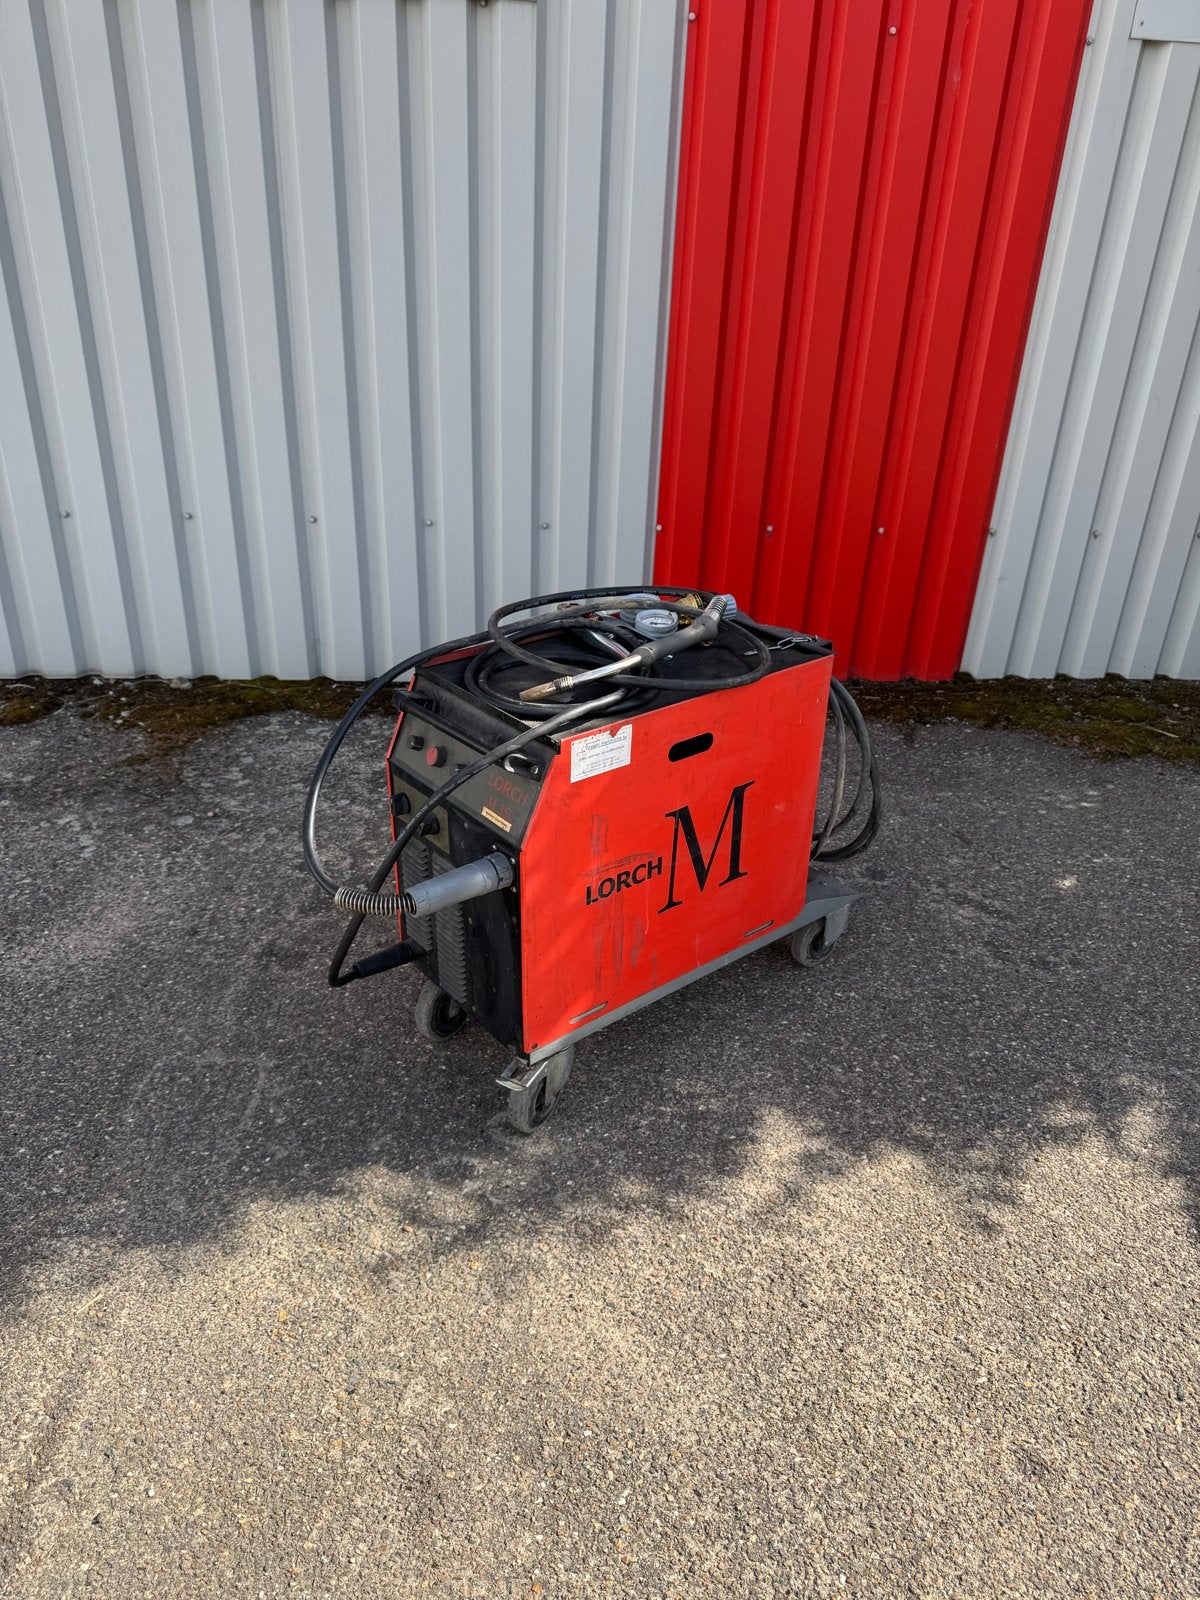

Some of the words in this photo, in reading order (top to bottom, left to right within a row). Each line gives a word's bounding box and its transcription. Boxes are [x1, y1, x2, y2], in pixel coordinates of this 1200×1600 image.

[487, 771, 529, 806] LORCH
[586, 856, 663, 906] LORCH
[657, 780, 755, 914] M
